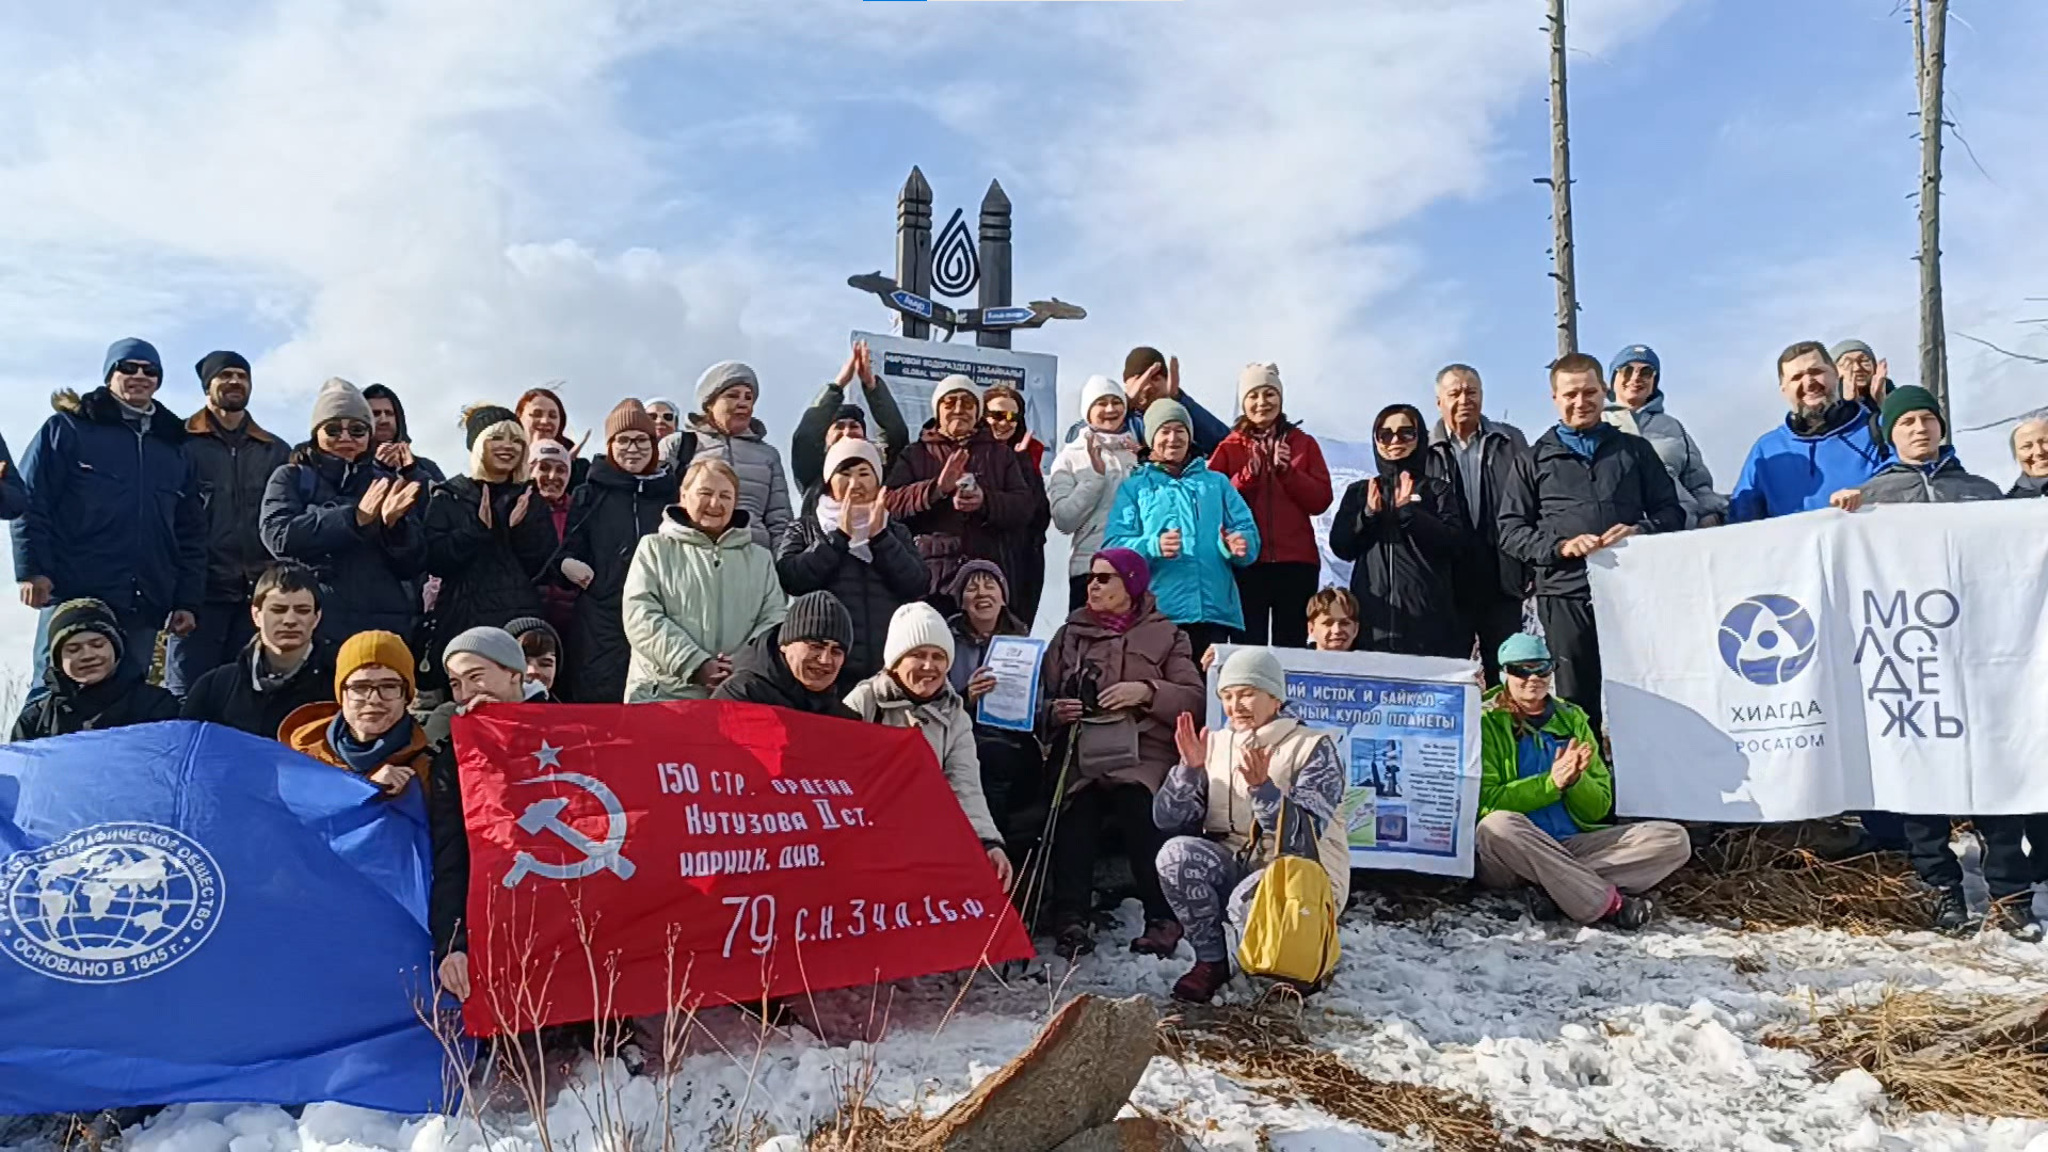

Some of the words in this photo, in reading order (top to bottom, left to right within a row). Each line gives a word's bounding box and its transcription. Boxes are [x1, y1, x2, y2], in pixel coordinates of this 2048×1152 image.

[1287, 682, 1306, 699] ИЙ
[1313, 686, 1357, 702] ИСТОК
[1363, 690, 1374, 703] И
[1380, 689, 1436, 707] БАЙКАЛ
[1299, 704, 1330, 720] НЫЙ
[1336, 708, 1382, 724] КУПОЛ
[1387, 711, 1457, 730] ПЛАНЕТЫ
[1731, 699, 1822, 723] ХИАГДА
[1735, 733, 1825, 753] РОСАТОМ
[657, 762, 700, 795] 150
[177, 846, 215, 931] ОБЩЕСТВО
[721, 894, 776, 958] 79
[13, 937, 109, 977] ОСНОВАНО
[112, 961, 126, 976] В
[130, 947, 169, 973] 1845
